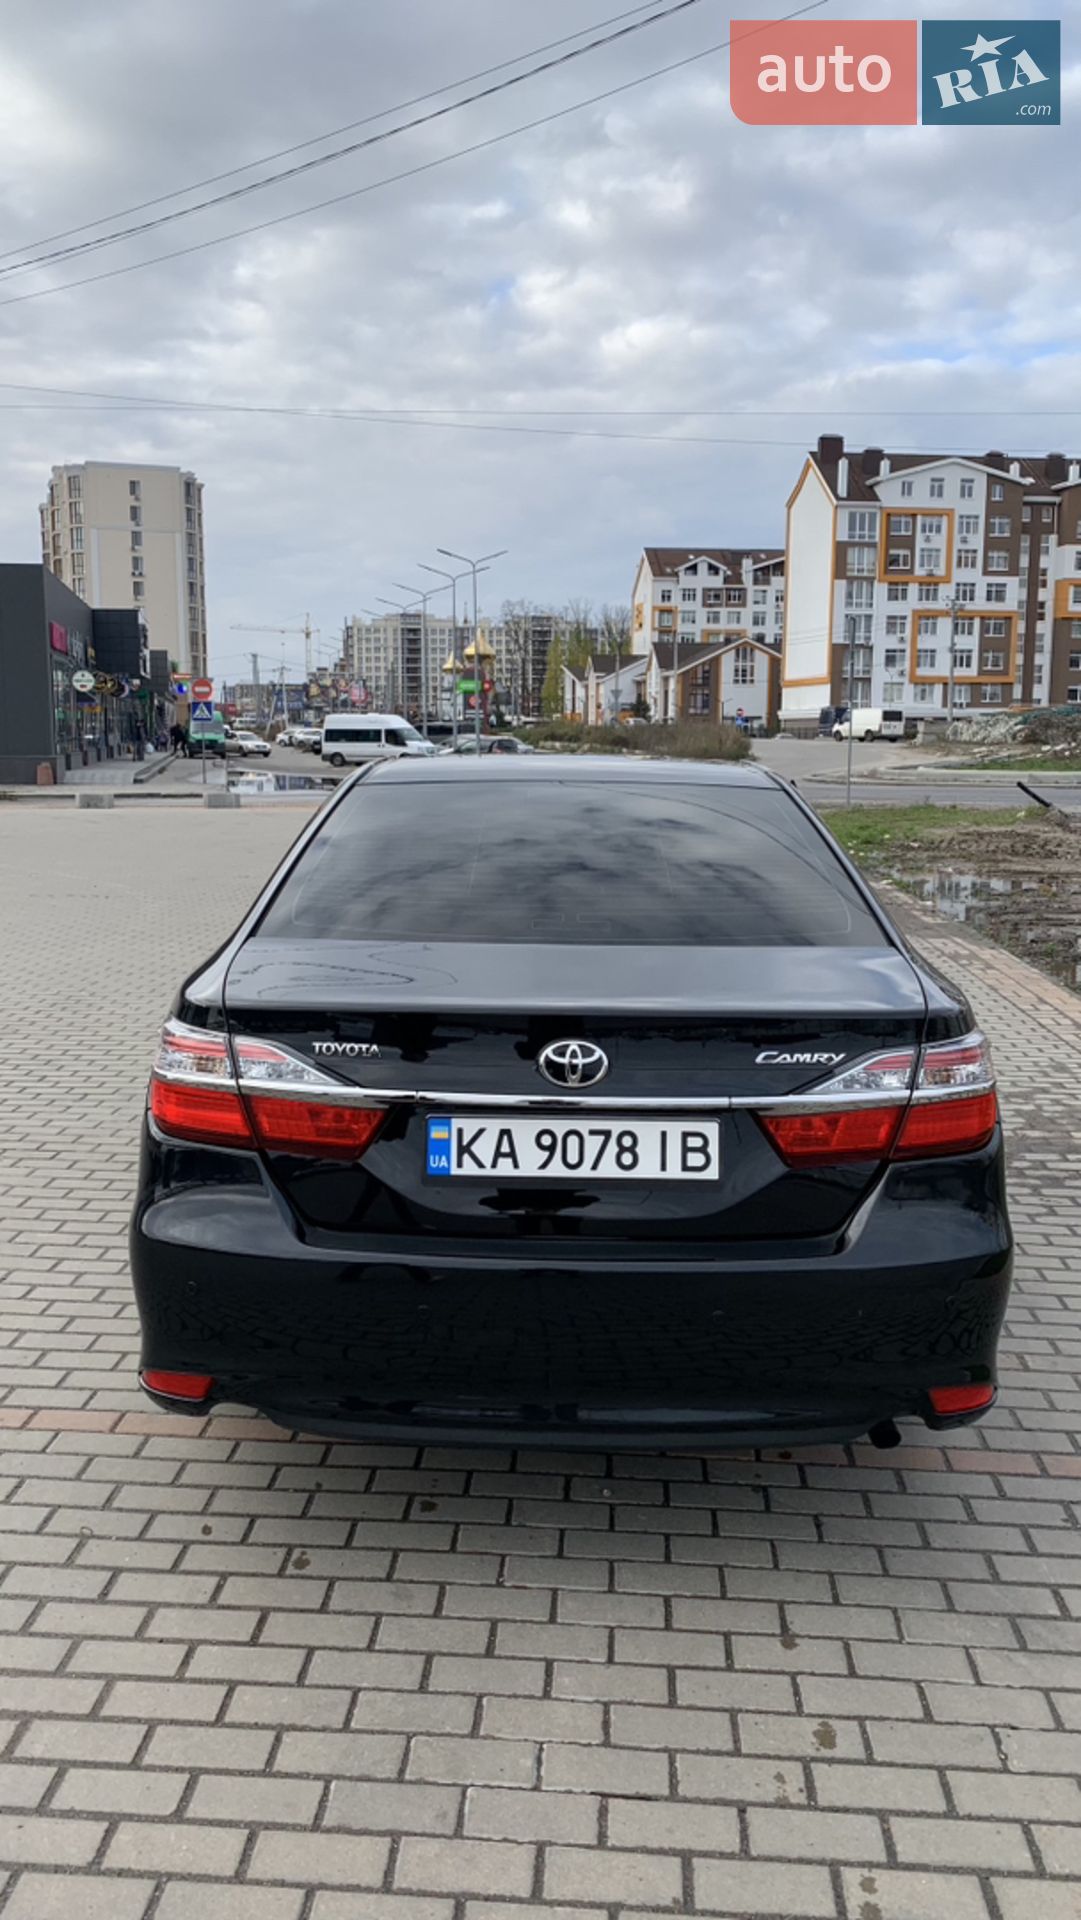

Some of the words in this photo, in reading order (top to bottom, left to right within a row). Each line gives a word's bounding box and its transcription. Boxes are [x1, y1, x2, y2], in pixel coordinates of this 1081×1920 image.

[312, 1042, 381, 1057] TOYOTA
[755, 1050, 846, 1065] CAMRY
[457, 1127, 520, 1169] KA
[535, 1128, 639, 1171] 9078
[660, 1130, 712, 1172] IB
[430, 1155, 448, 1168] UA
